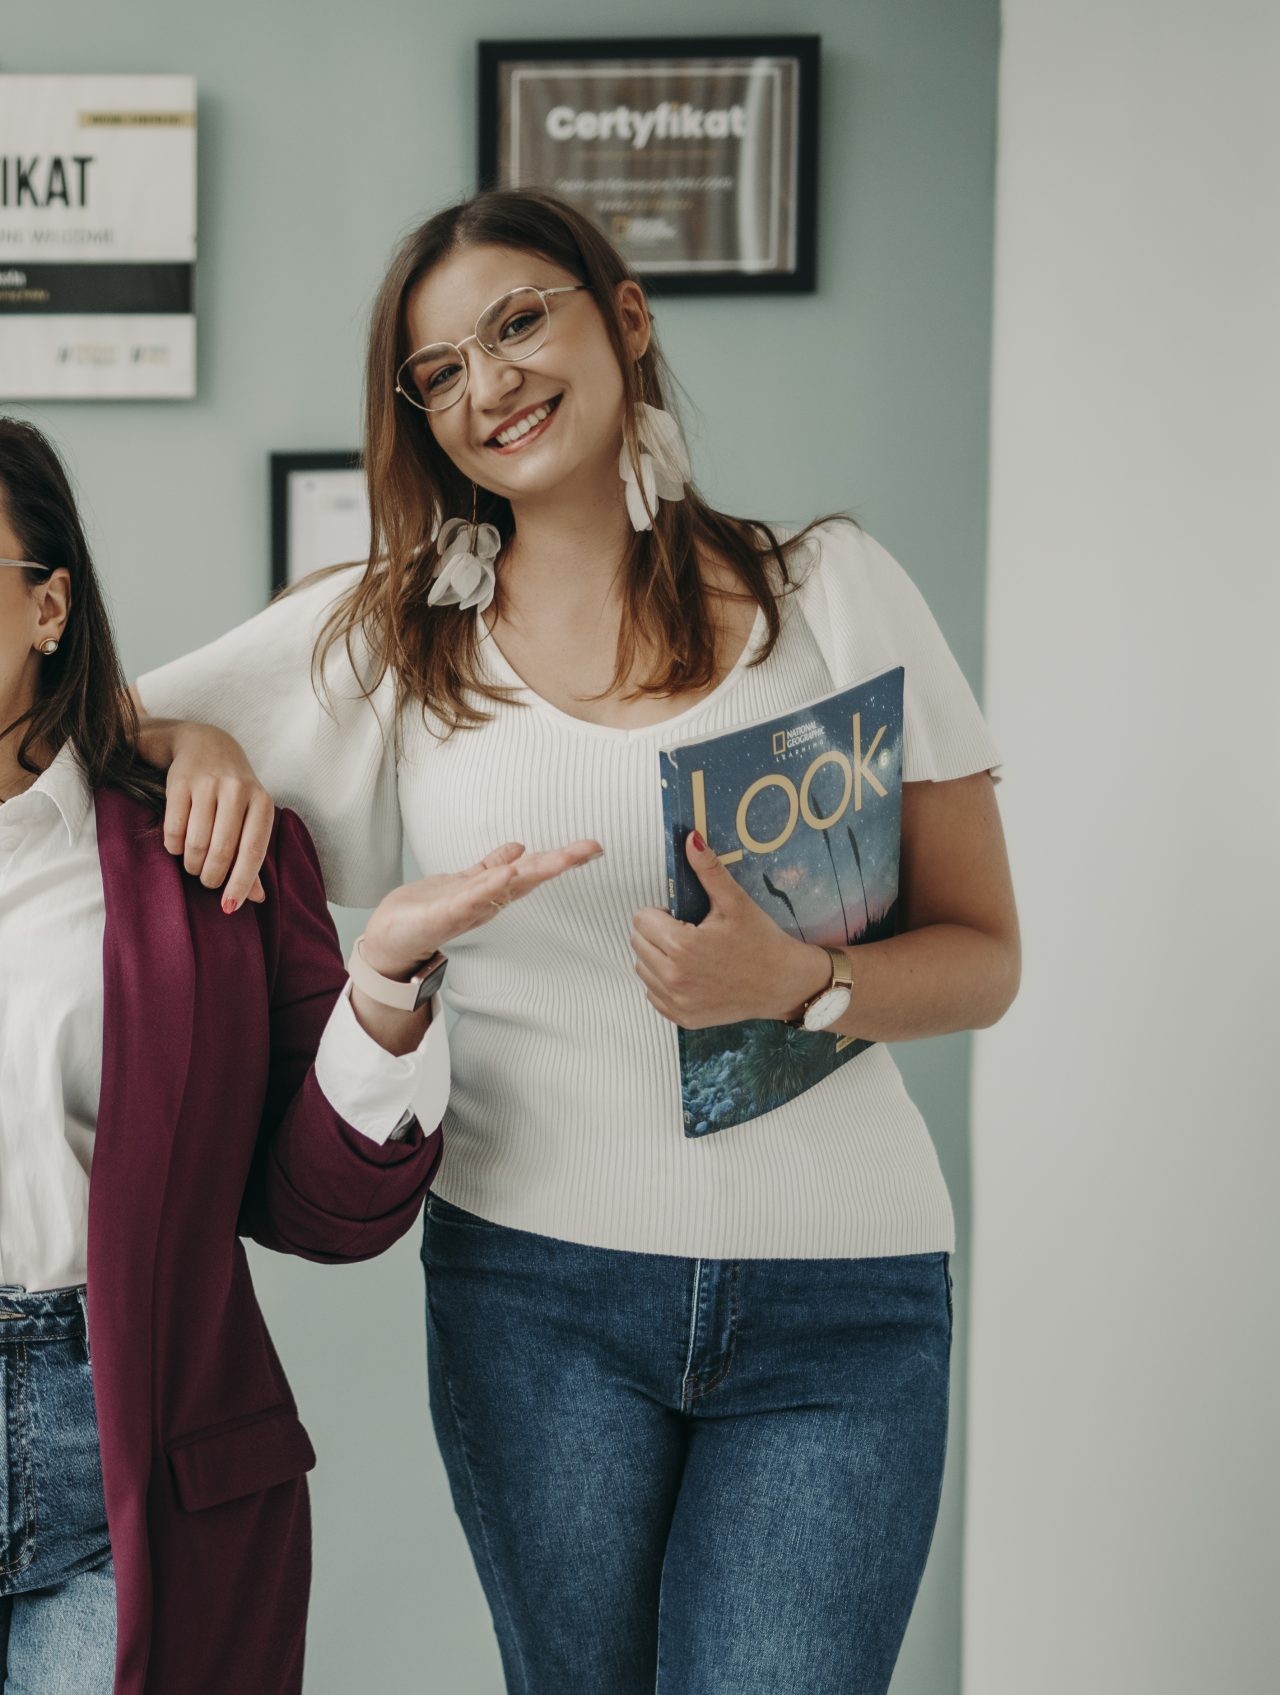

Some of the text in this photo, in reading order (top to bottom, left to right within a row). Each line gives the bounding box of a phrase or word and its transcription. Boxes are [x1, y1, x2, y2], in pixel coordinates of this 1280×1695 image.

[546, 101, 748, 149] Certyfikat
[787, 721, 817, 739] NATIONAL
[787, 726, 826, 749] GEOGRAPHIC
